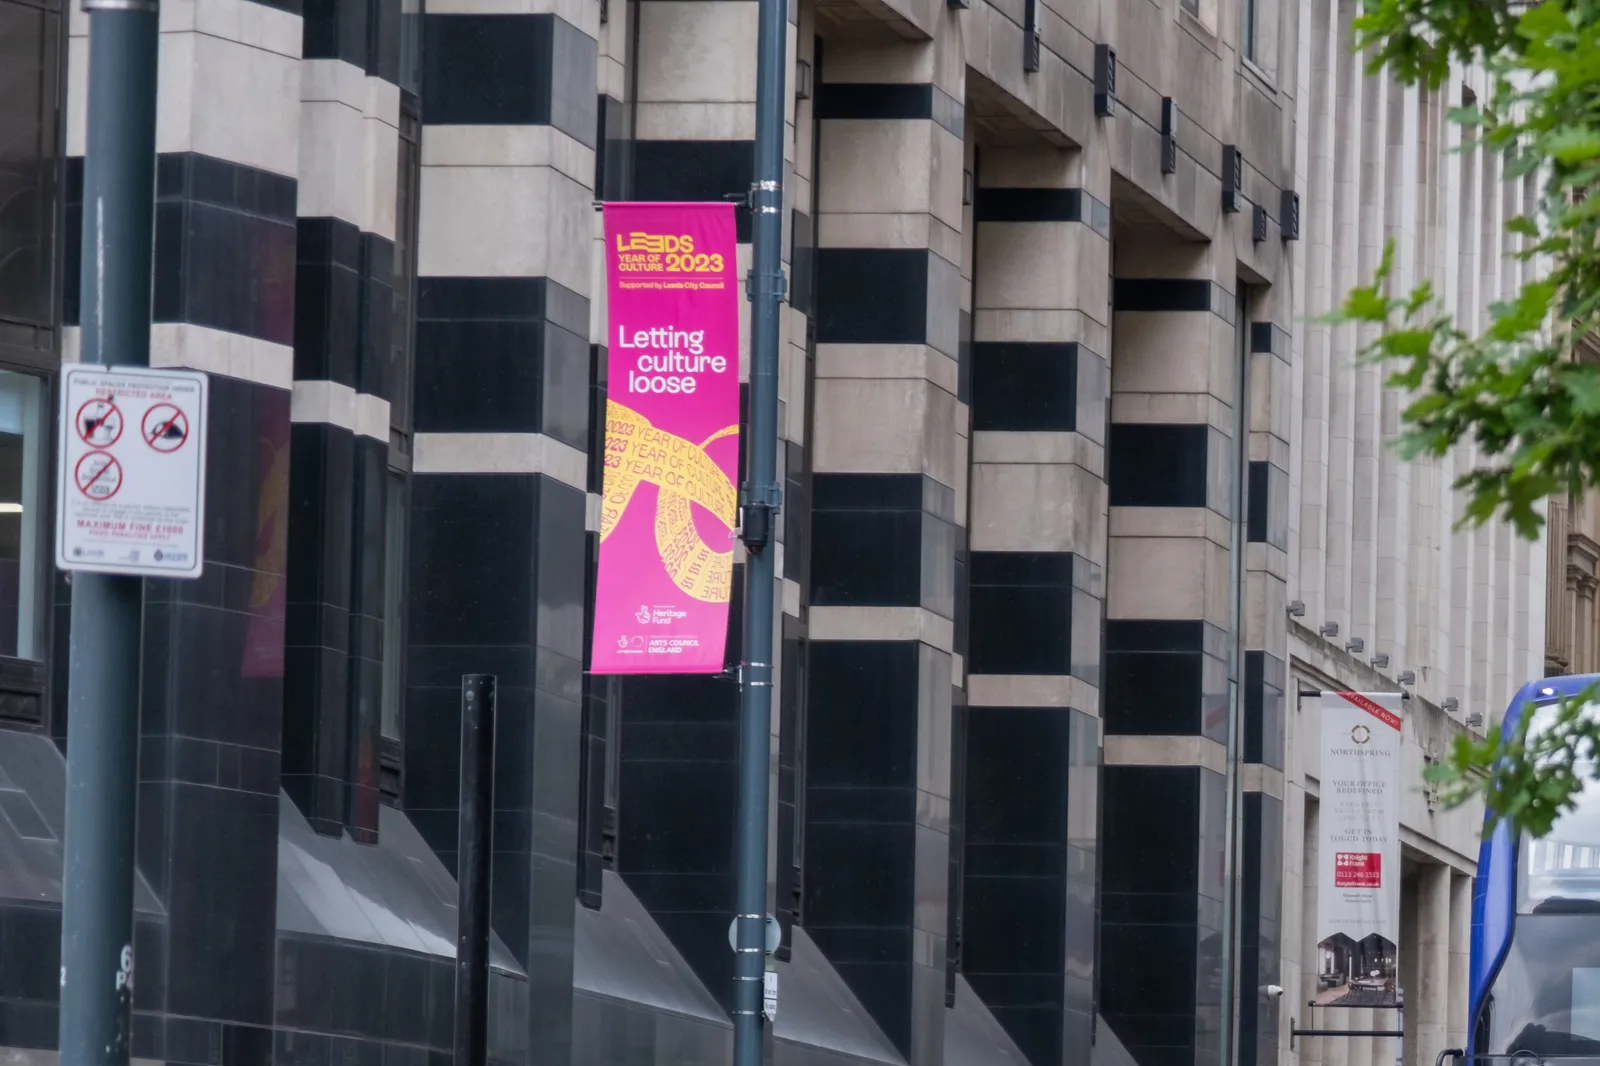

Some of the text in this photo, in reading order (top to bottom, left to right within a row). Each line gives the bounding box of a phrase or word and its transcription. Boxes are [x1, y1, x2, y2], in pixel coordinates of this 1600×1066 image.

[616, 232, 694, 253] LEEDS
[618, 253, 724, 272] YEAR OF 2023
[618, 263, 664, 272] CULTURE
[619, 281, 724, 291] Supported by Leeds City Council
[619, 325, 704, 355] Letting
[637, 349, 727, 373] culture
[629, 370, 696, 394] loose
[77, 519, 126, 531] MAXIMUM
[129, 522, 152, 532] FINE
[652, 609, 687, 618] Heritage
[648, 639, 667, 647] ARTS
[648, 646, 682, 654] ENGLAND
[1330, 748, 1391, 757] NORTHSPRING
[1336, 787, 1383, 795] REDEFINED
